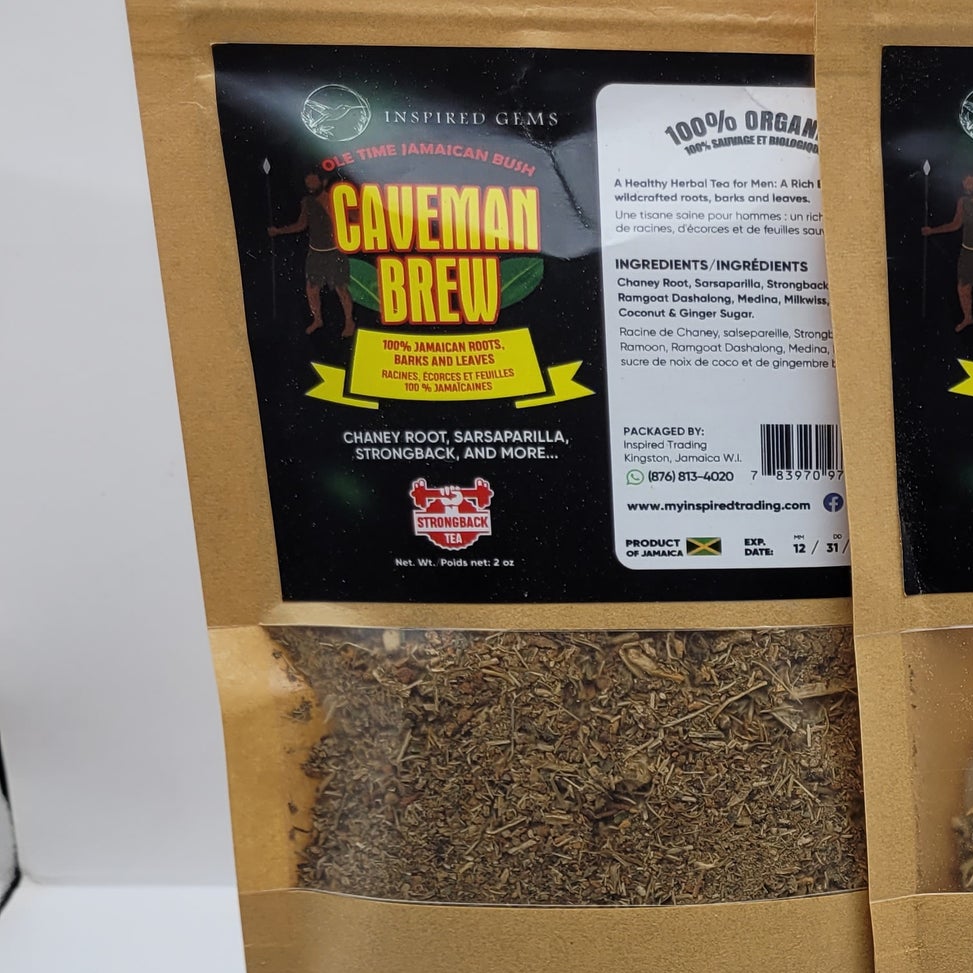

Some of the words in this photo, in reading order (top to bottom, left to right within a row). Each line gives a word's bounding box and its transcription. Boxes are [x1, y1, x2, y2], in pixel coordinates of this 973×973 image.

[384, 110, 485, 125] INSPIRED
[495, 111, 559, 126] GEMS
[664, 109, 737, 146] 100%
[744, 110, 819, 140] ORGAN
[768, 137, 819, 155] BIOLOGIQU
[321, 153, 355, 173] OLE
[356, 144, 397, 161] TIME
[400, 143, 488, 162] JAMAICAN
[492, 154, 537, 177] BUSH
[614, 179, 622, 188] A
[625, 179, 668, 191] Healthy
[670, 179, 708, 189] Herbal
[710, 180, 730, 189] Tea
[732, 179, 748, 189] for
[751, 180, 777, 189] Men:
[780, 180, 789, 189] A
[791, 179, 815, 189] Rich
[614, 193, 678, 203] wildcrafted
[680, 194, 712, 204] roots,
[714, 193, 745, 203] barks
[748, 193, 769, 203] and
[772, 193, 811, 204] leaves.
[329, 182, 540, 253] CAVEMAN
[615, 224, 631, 233] de
[633, 224, 675, 235] racines,
[677, 224, 730, 234] d'écorces
[732, 225, 744, 234] et
[746, 225, 761, 234] de
[763, 224, 800, 235] feuilles
[615, 257, 808, 273] INGREDIENTS/INGRÉDIENTS
[377, 256, 501, 324] BREW
[617, 278, 660, 289] Chaney
[663, 278, 692, 289] Root,
[694, 278, 764, 291] Sarsaparilla,
[618, 293, 669, 305] Ramgoat
[672, 293, 735, 306] Dashalong,
[737, 294, 782, 306] Medina,
[784, 294, 830, 307] Milkwiss,
[618, 308, 666, 318] Coconut
[668, 309, 677, 318] &
[679, 308, 717, 320] Ginger
[719, 309, 755, 320] Sugar.
[382, 339, 412, 350] 100%
[413, 340, 467, 353] JAMAICAN
[468, 339, 505, 351] ROOTS,
[394, 354, 429, 366] BARKS
[431, 354, 454, 367] AND
[456, 353, 495, 365] LEAVES
[381, 369, 421, 382] RACINES,
[422, 369, 462, 381] ÉCORCES
[463, 371, 474, 380] ET
[475, 368, 515, 380] FEUILLES
[404, 382, 420, 392] 100
[421, 383, 432, 392] %
[433, 381, 493, 393] JAMAÏCAINES
[343, 431, 401, 444] CHANEY
[405, 431, 450, 445] ROOT,
[454, 430, 570, 445] SARSAPARILLA,
[623, 427, 685, 436] PACKAGED
[687, 427, 705, 436] BY:
[623, 440, 665, 451] Inspired
[667, 440, 707, 451] Trading
[355, 447, 460, 461] STRONGBACK,
[464, 447, 496, 460] AND
[501, 447, 559, 460] MORE...
[624, 453, 672, 465] Kingston,
[674, 453, 721, 463] Jamaica
[723, 453, 742, 463] W.I.
[648, 470, 676, 482] (876)
[678, 471, 734, 482] 813-4020
[627, 499, 811, 513] www.myinspiredtrading.com
[416, 516, 489, 529] STRONGBACK
[443, 533, 463, 544] TEA
[625, 539, 680, 547] PRODUCT
[744, 538, 766, 547] EXP.
[641, 549, 683, 557] JAMAICA
[744, 548, 774, 556] DATE:
[395, 558, 415, 567] Net.
[440, 558, 468, 567] Poids
[470, 558, 491, 567] net:
[494, 558, 500, 567] 2
[502, 559, 514, 567] oz
